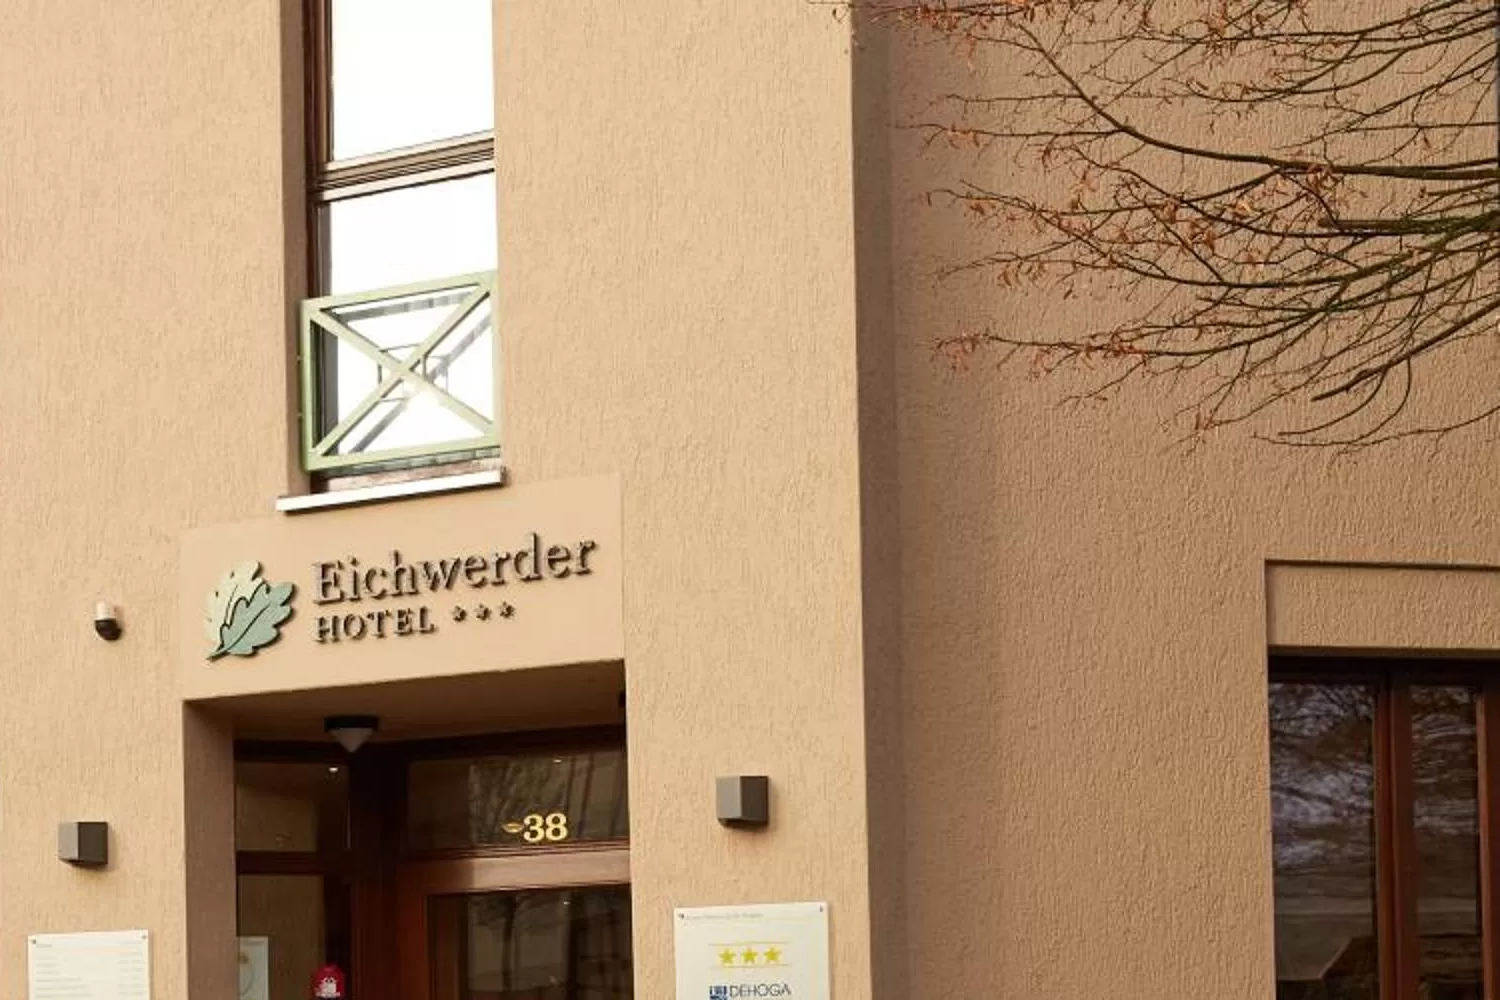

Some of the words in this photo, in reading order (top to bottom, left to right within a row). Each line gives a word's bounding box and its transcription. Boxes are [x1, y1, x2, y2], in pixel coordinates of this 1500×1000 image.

[312, 532, 599, 606] Eichwerder
[313, 605, 438, 645] HOTEL
[523, 813, 569, 843] 38
[729, 983, 793, 999] DEHOGA
